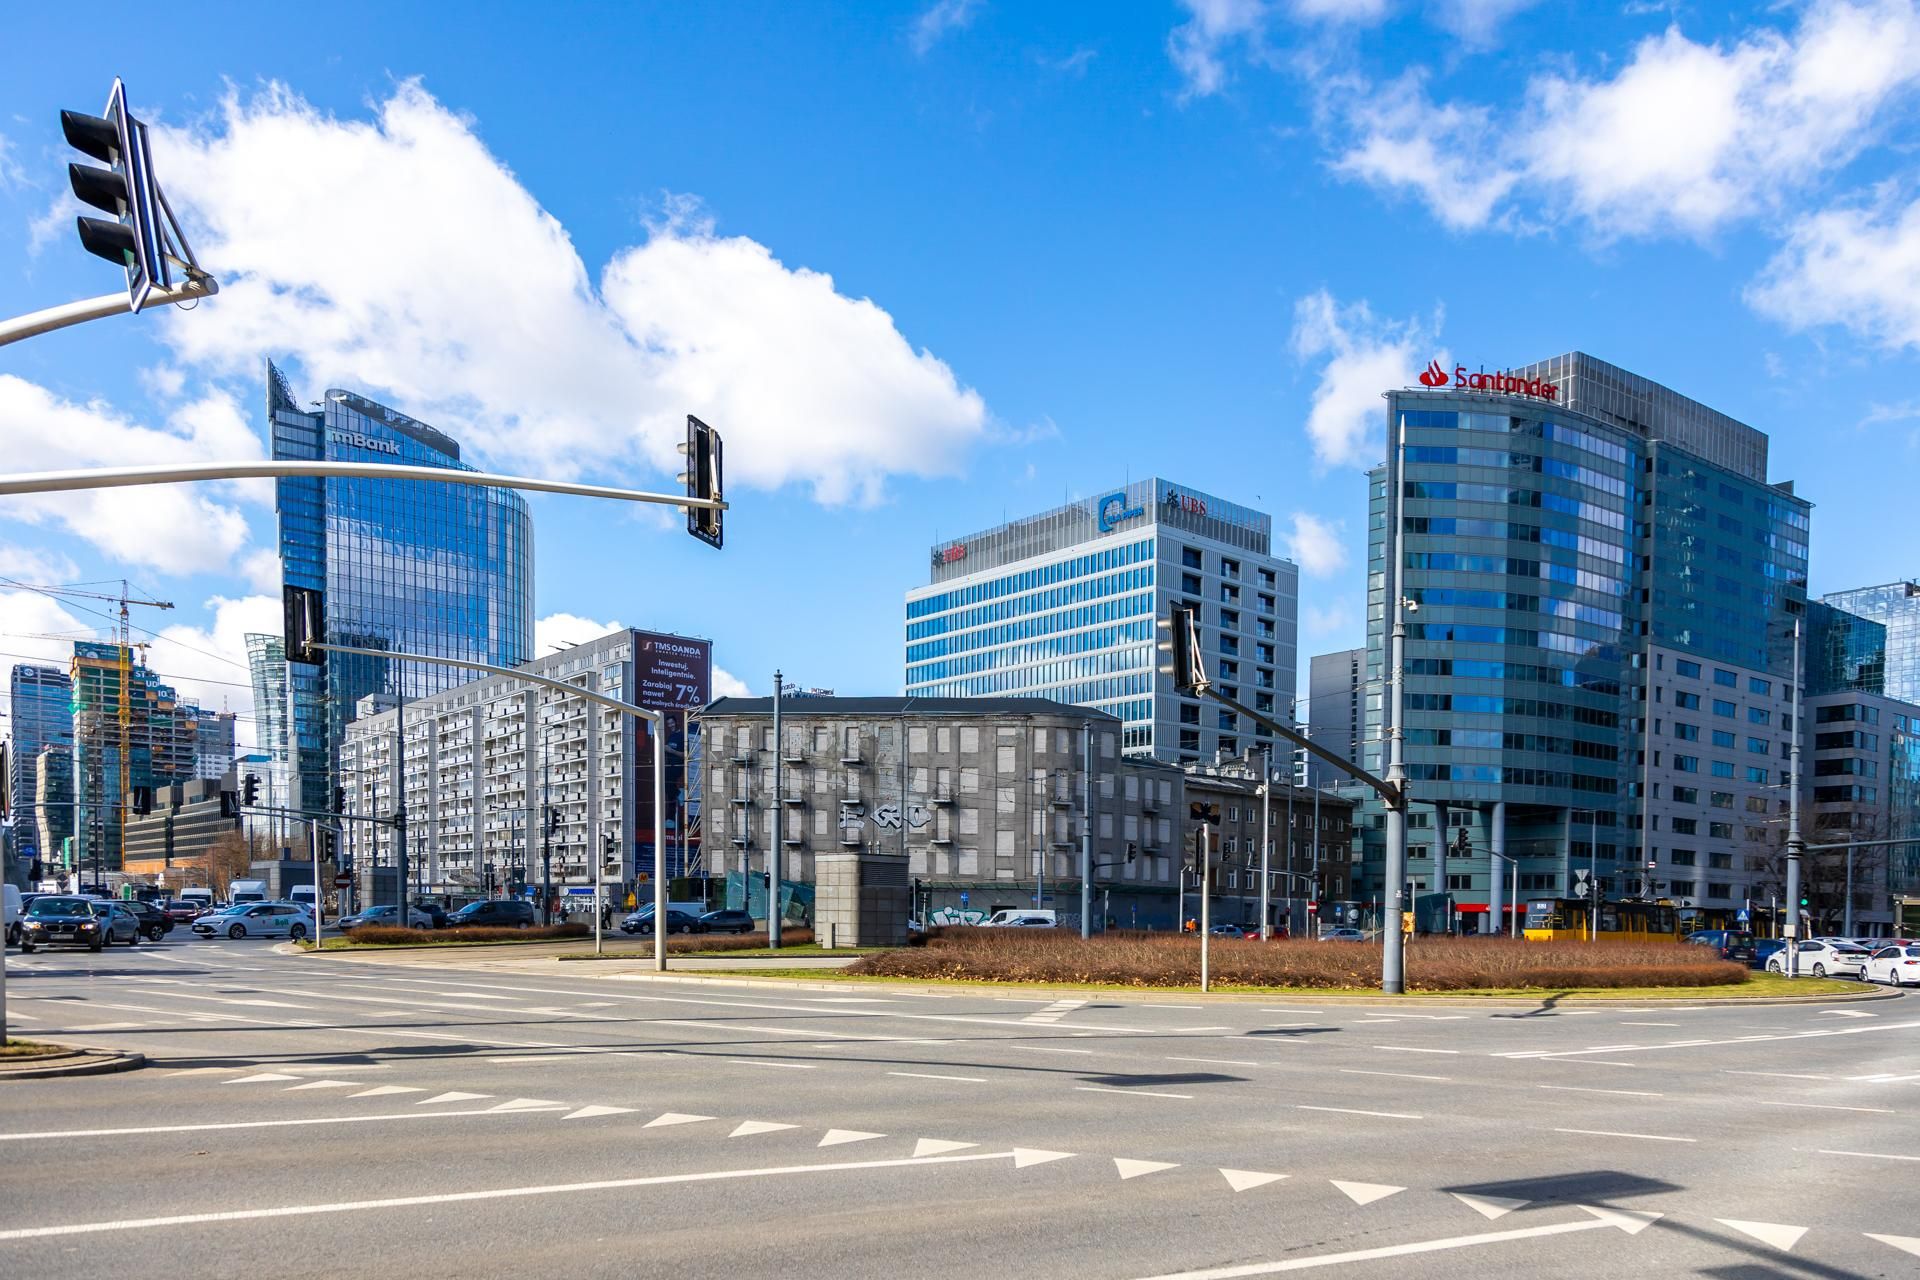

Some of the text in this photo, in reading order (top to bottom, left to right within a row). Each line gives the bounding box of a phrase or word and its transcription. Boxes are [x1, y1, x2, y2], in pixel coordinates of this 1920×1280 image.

[1455, 367, 1558, 400] Santander
[332, 431, 400, 455] mBank
[1181, 494, 1206, 516] UBS
[1106, 506, 1144, 525] DLA PIPER
[943, 545, 965, 562] UBS
[654, 641, 701, 656] TMS OANDA
[651, 667, 696, 680] Inteligentnie.
[658, 659, 689, 671] Inwestuj.
[642, 679, 672, 691] Zarabiaj
[675, 684, 700, 703] 7%
[642, 690, 664, 698] nawet
